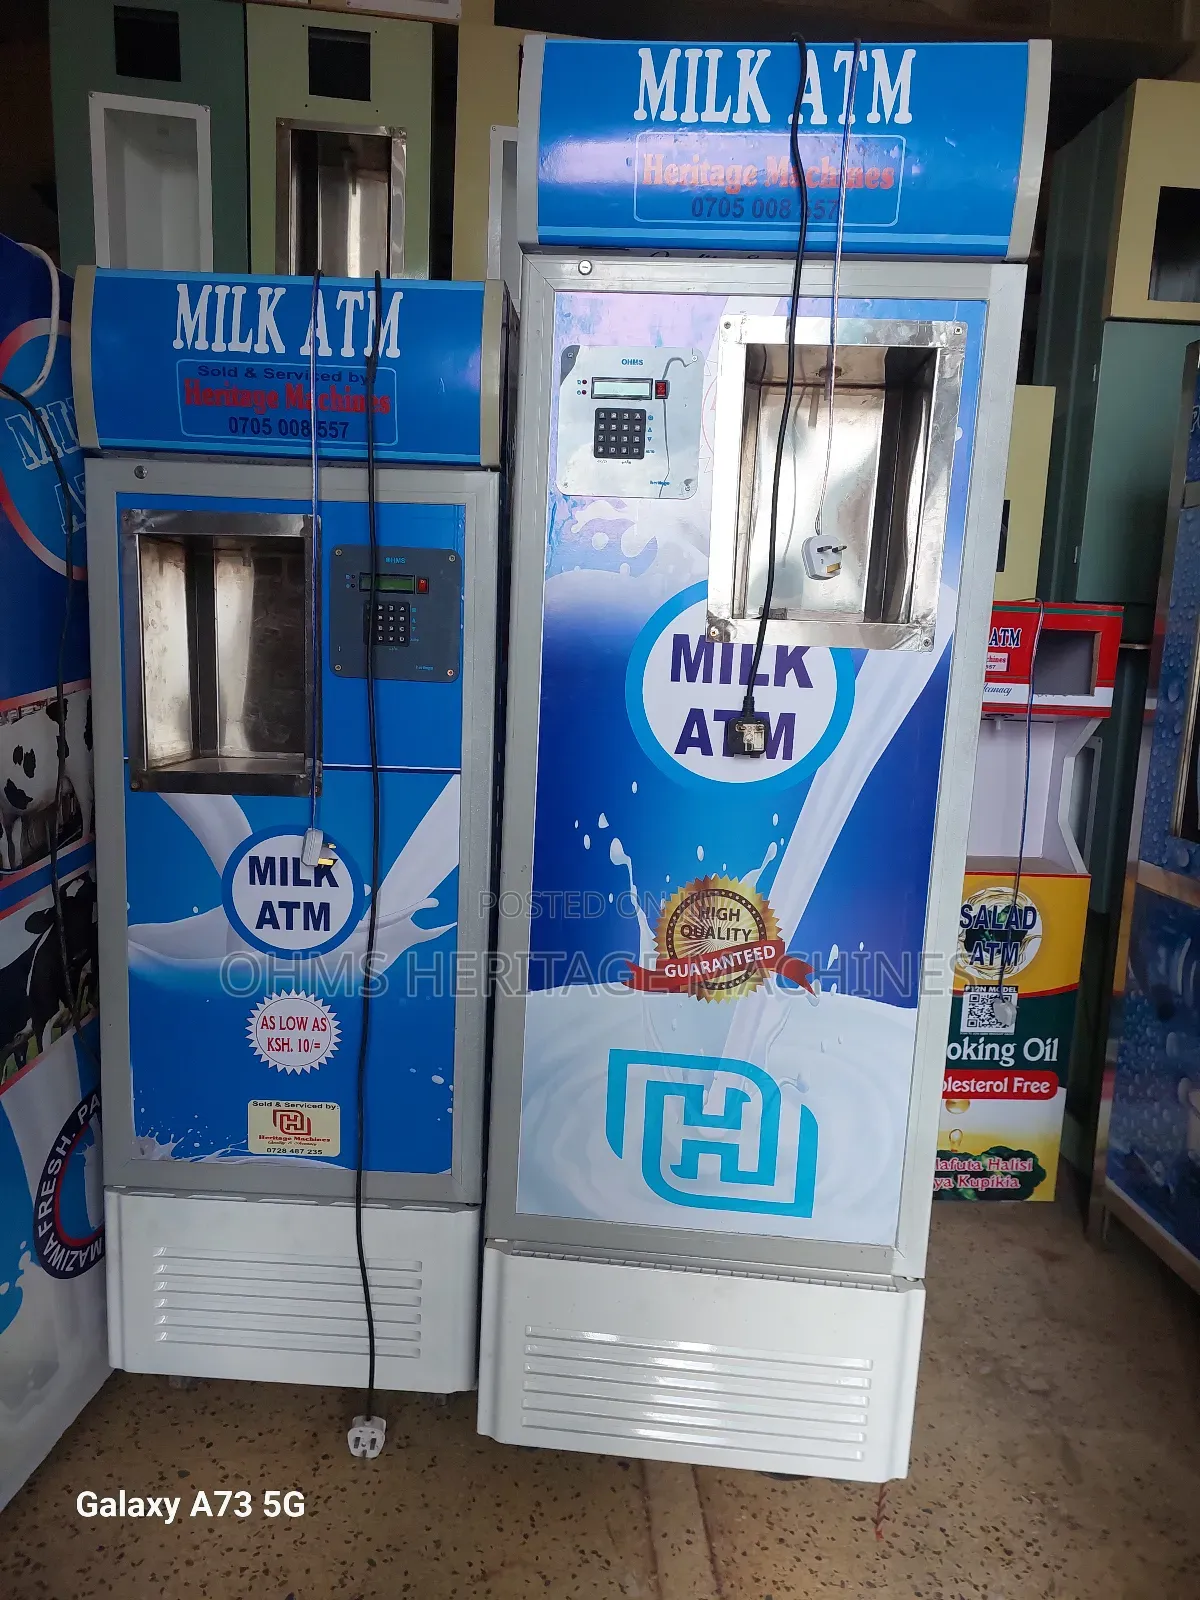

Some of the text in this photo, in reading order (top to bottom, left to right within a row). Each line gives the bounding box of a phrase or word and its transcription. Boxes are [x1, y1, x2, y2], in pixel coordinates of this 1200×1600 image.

[634, 47, 917, 125] MILK ATM
[643, 153, 758, 194] Heritage
[691, 197, 744, 219] 0705
[752, 198, 791, 219] 008
[172, 283, 404, 358] MILK ATM
[198, 366, 238, 378] Sold
[244, 367, 257, 378] &
[621, 358, 644, 366] OHMS
[184, 377, 279, 415] Heritage
[228, 416, 350, 439] 0705 008 557
[988, 626, 1023, 650] ATM
[670, 633, 814, 689] MILK
[248, 855, 340, 888] MILK
[255, 900, 331, 932] ATM
[699, 906, 741, 923] HIGH
[959, 903, 1037, 930] SALAD
[680, 924, 753, 942] QUALITY
[664, 945, 776, 979] GUARANTEED
[969, 940, 1019, 967] ATM
[260, 1015, 328, 1032] AS LOW AS
[266, 1037, 321, 1053] KSH. 10/=
[1023, 1037, 1059, 1062] Oil
[1013, 1077, 1051, 1094] Free
[986, 1157, 1034, 1172] Halisi
[957, 1174, 1021, 1192] Kupikia
